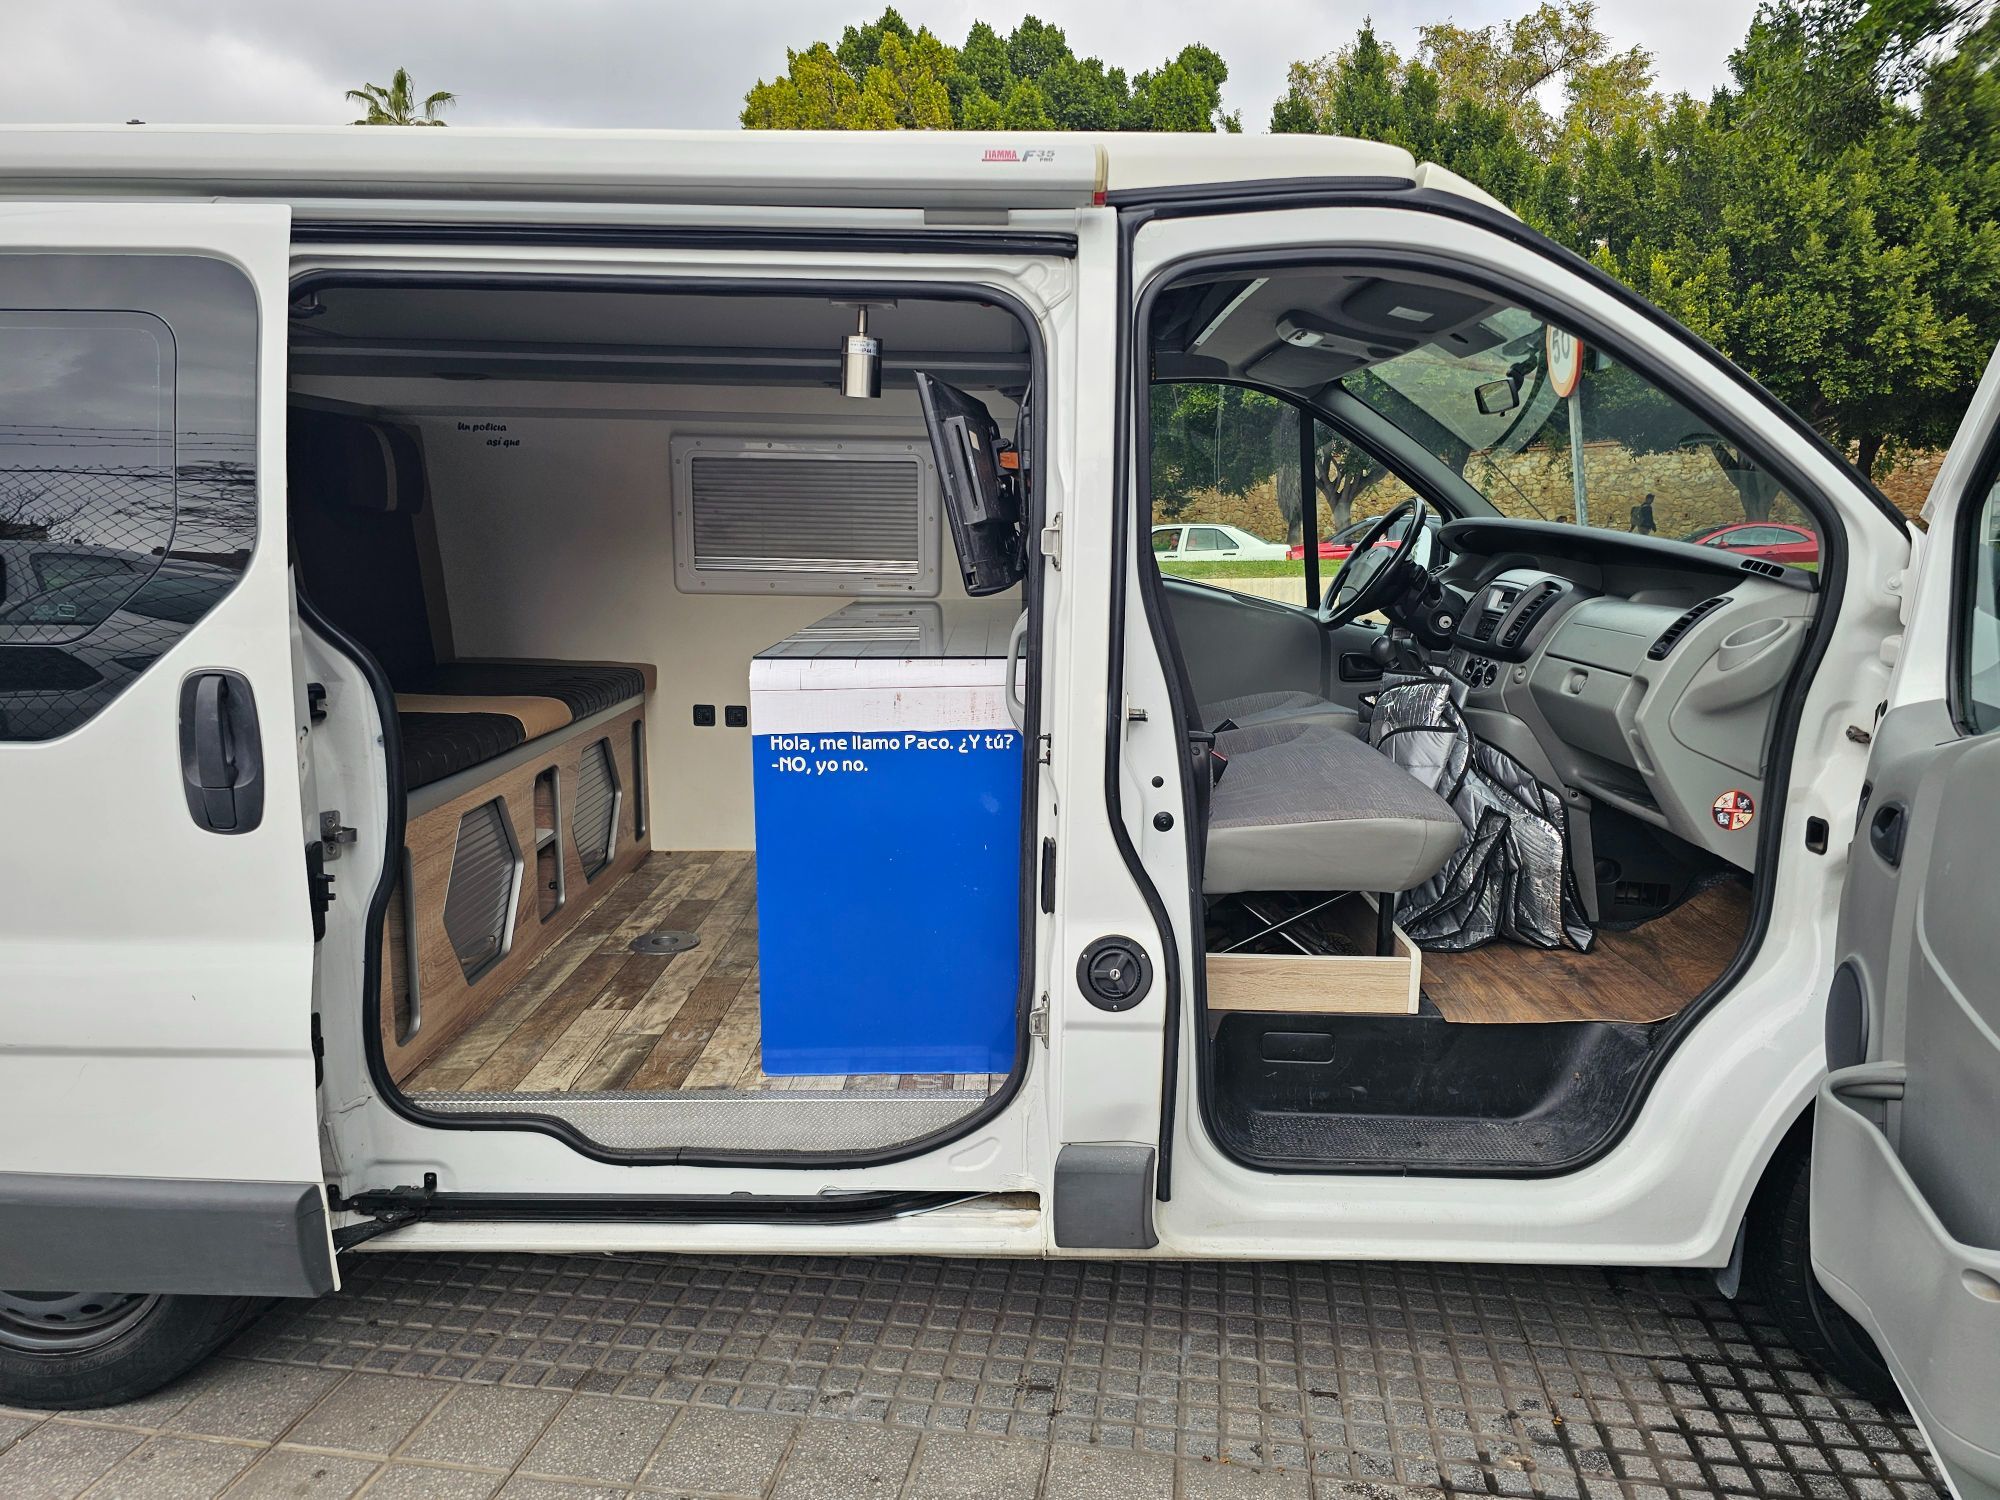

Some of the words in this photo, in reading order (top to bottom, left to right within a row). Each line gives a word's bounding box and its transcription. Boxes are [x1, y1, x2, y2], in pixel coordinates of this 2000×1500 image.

[1552, 329, 1570, 364] 50
[457, 421, 471, 430] Un
[503, 439, 520, 448] que
[770, 735, 816, 754] Hola,
[820, 739, 848, 751] me
[852, 735, 900, 751] llamo
[904, 734, 954, 750] Paco.
[958, 734, 980, 753] ¿Y
[984, 733, 1014, 750] tú?
[771, 756, 812, 775] -NO,
[815, 760, 839, 776] yo
[842, 759, 868, 772] no.
